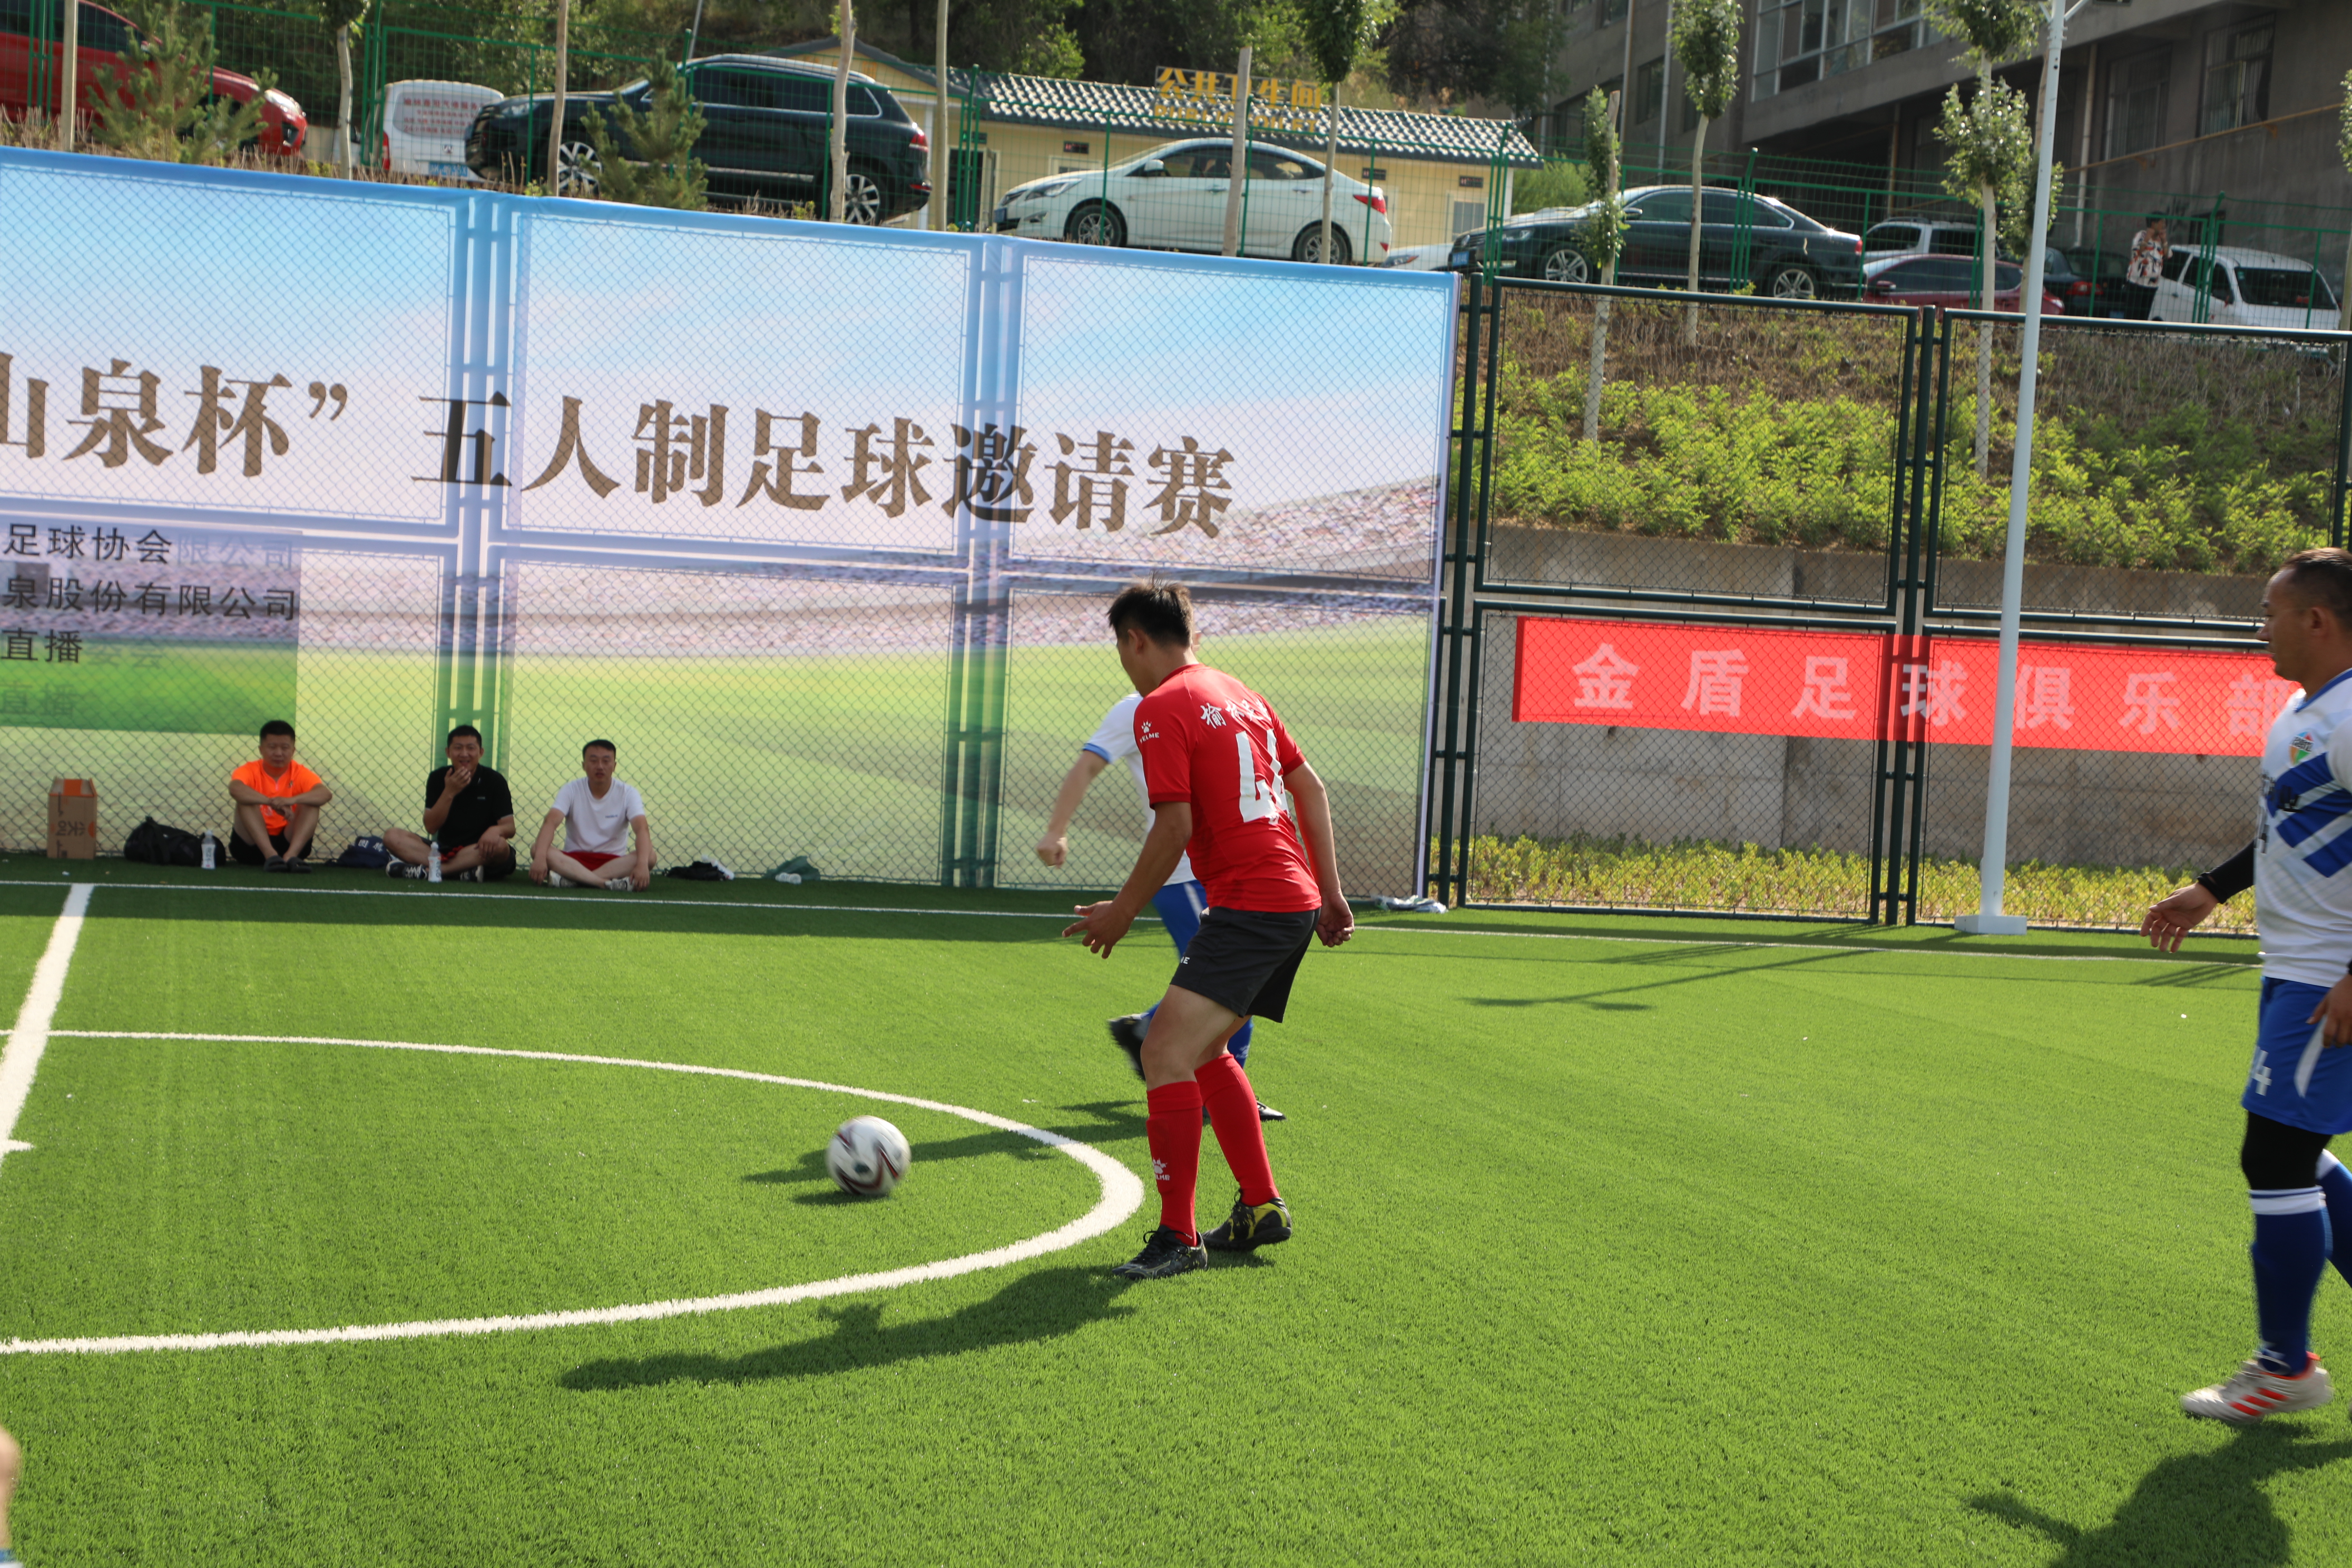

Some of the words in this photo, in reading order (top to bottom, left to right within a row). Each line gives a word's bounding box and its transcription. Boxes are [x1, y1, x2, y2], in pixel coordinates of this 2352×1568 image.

[1158, 67, 1321, 112] 公共卫生间
[1248, 114, 1317, 133] OILET
[3, 523, 172, 564] 足球协会
[2, 575, 296, 621] 泉股份有限公司
[1, 626, 83, 663] 直播
[1573, 643, 2291, 745] 金盾足球俱乐部
